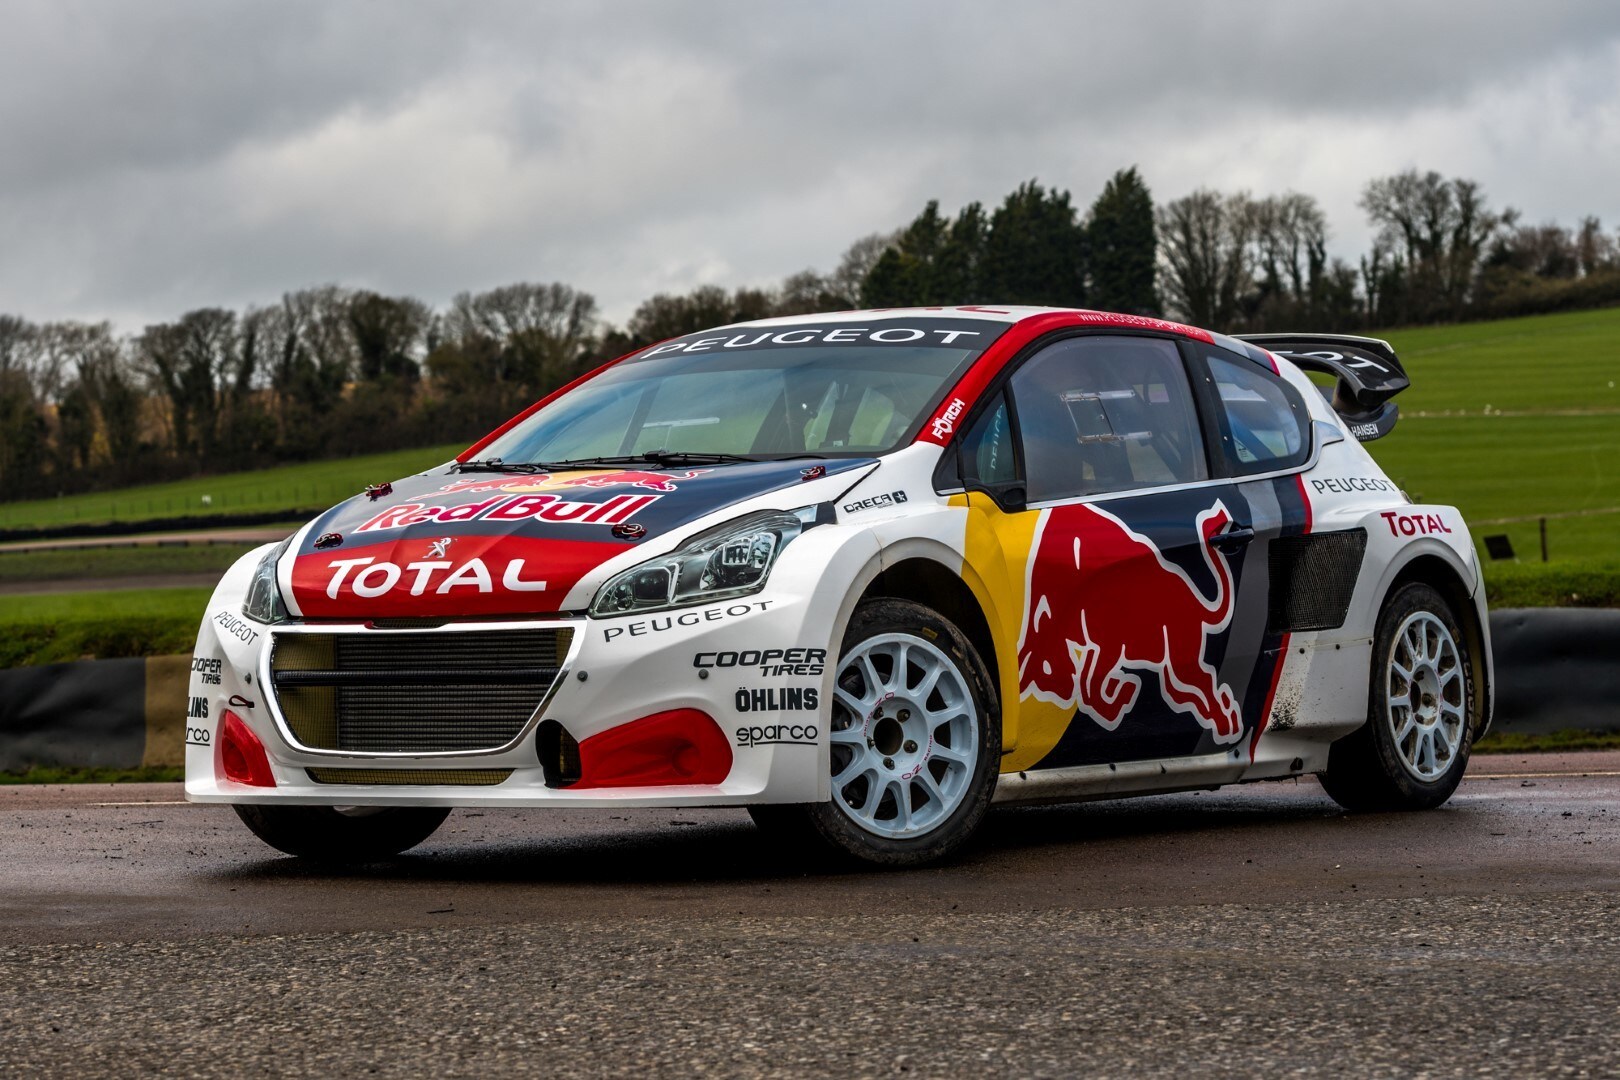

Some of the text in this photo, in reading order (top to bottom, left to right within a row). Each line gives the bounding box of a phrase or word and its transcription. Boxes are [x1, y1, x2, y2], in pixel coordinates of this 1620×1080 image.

[641, 328, 980, 359] PEUGEOT
[931, 397, 966, 440] FÖRCH
[1350, 423, 1379, 436] HANSEN
[1311, 477, 1396, 495] PEUGEOT
[351, 494, 665, 534] Red Bull
[843, 493, 893, 514] ORECA
[1380, 511, 1452, 538] TOTAL
[326, 557, 547, 600] TOTAL
[214, 611, 259, 646] PEUGEOT
[603, 600, 774, 643] PEUGEOT
[693, 648, 827, 668] COOPER
[759, 664, 824, 677] TIRES
[735, 686, 818, 712] ÖHLINS
[736, 725, 818, 748] sparco
